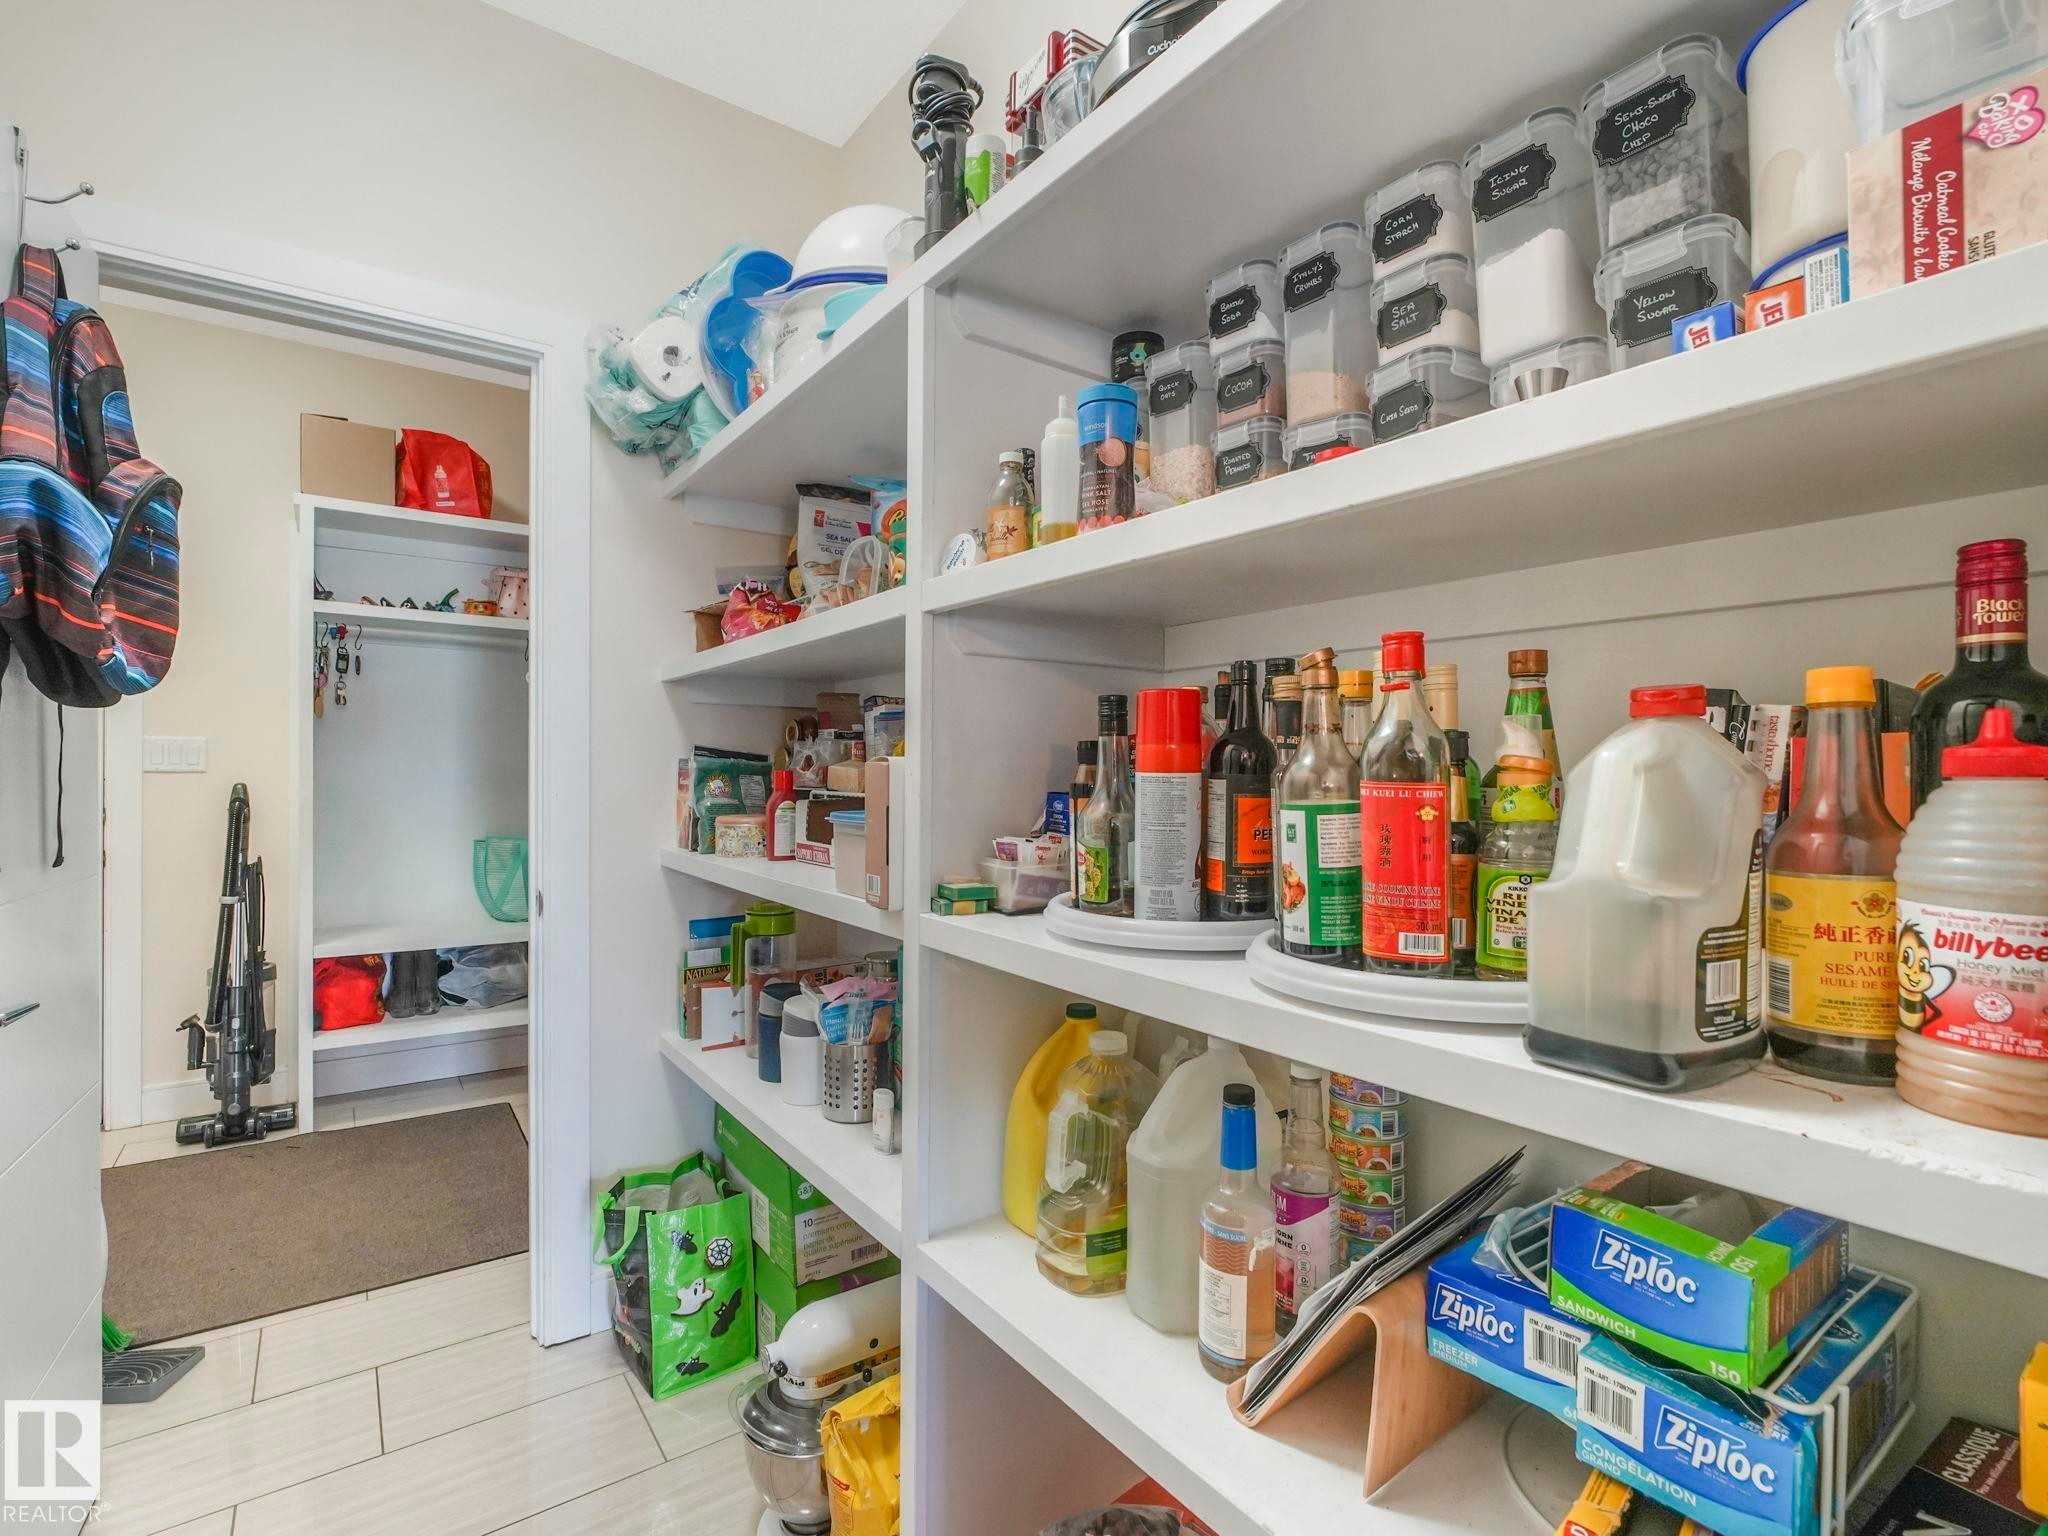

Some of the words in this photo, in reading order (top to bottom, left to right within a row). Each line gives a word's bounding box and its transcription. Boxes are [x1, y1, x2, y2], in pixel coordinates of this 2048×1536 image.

[1622, 114, 1659, 138] CHOCO
[1621, 132, 1651, 154] CHIP
[1489, 163, 1530, 187] ICING
[1907, 138, 1931, 191] Mélange
[1491, 177, 1529, 201] SUGAR
[1935, 170, 1957, 226] Oatmeal
[1384, 210, 1414, 232] CORN
[1912, 192, 1932, 245] Biscuits
[1384, 220, 1420, 247] STARCH
[1936, 226, 1958, 270] Cookie
[1294, 274, 1324, 295] CRUMBS
[1634, 289, 1675, 308] YELLOW
[1221, 311, 1241, 325] SODA
[1391, 301, 1417, 319] SEA
[1637, 304, 1679, 322] SUGAR
[1391, 313, 1420, 331] SALT
[1224, 378, 1253, 397] COCOA
[1976, 598, 2025, 613] Black
[1972, 611, 2025, 625] Tower
[1373, 789, 1395, 797] KUEI
[1399, 790, 1412, 798] LU
[1416, 790, 1444, 798] CHIEW
[1487, 898, 1527, 908] VINE
[1496, 916, 1519, 924] DE
[1934, 928, 2048, 962] billybee
[1854, 951, 1895, 963] PURE
[687, 967, 717, 980] NATURE
[1825, 963, 1892, 978] SESAME
[1957, 959, 2000, 975] Honey
[2011, 966, 2044, 978] Miel
[1820, 977, 1858, 989] HUILE
[1862, 980, 1878, 989] DE
[802, 1226, 835, 1241] premium
[803, 1218, 814, 1228] 10
[1602, 1236, 1698, 1303] Ziploc
[1440, 1288, 1516, 1344] Ziploc
[1557, 1295, 1636, 1340] SANDWICH
[1432, 1337, 1478, 1366] FREEZER
[1433, 1350, 1468, 1369] MEDIUM
[1709, 1360, 1741, 1385] 150
[1582, 1449, 1622, 1477] GRAND
[1664, 1412, 1775, 1494] Ziploc
[1941, 1428, 2000, 1483] CLASSIQUE
[1581, 1438, 1697, 1507] CONGÉLATION
